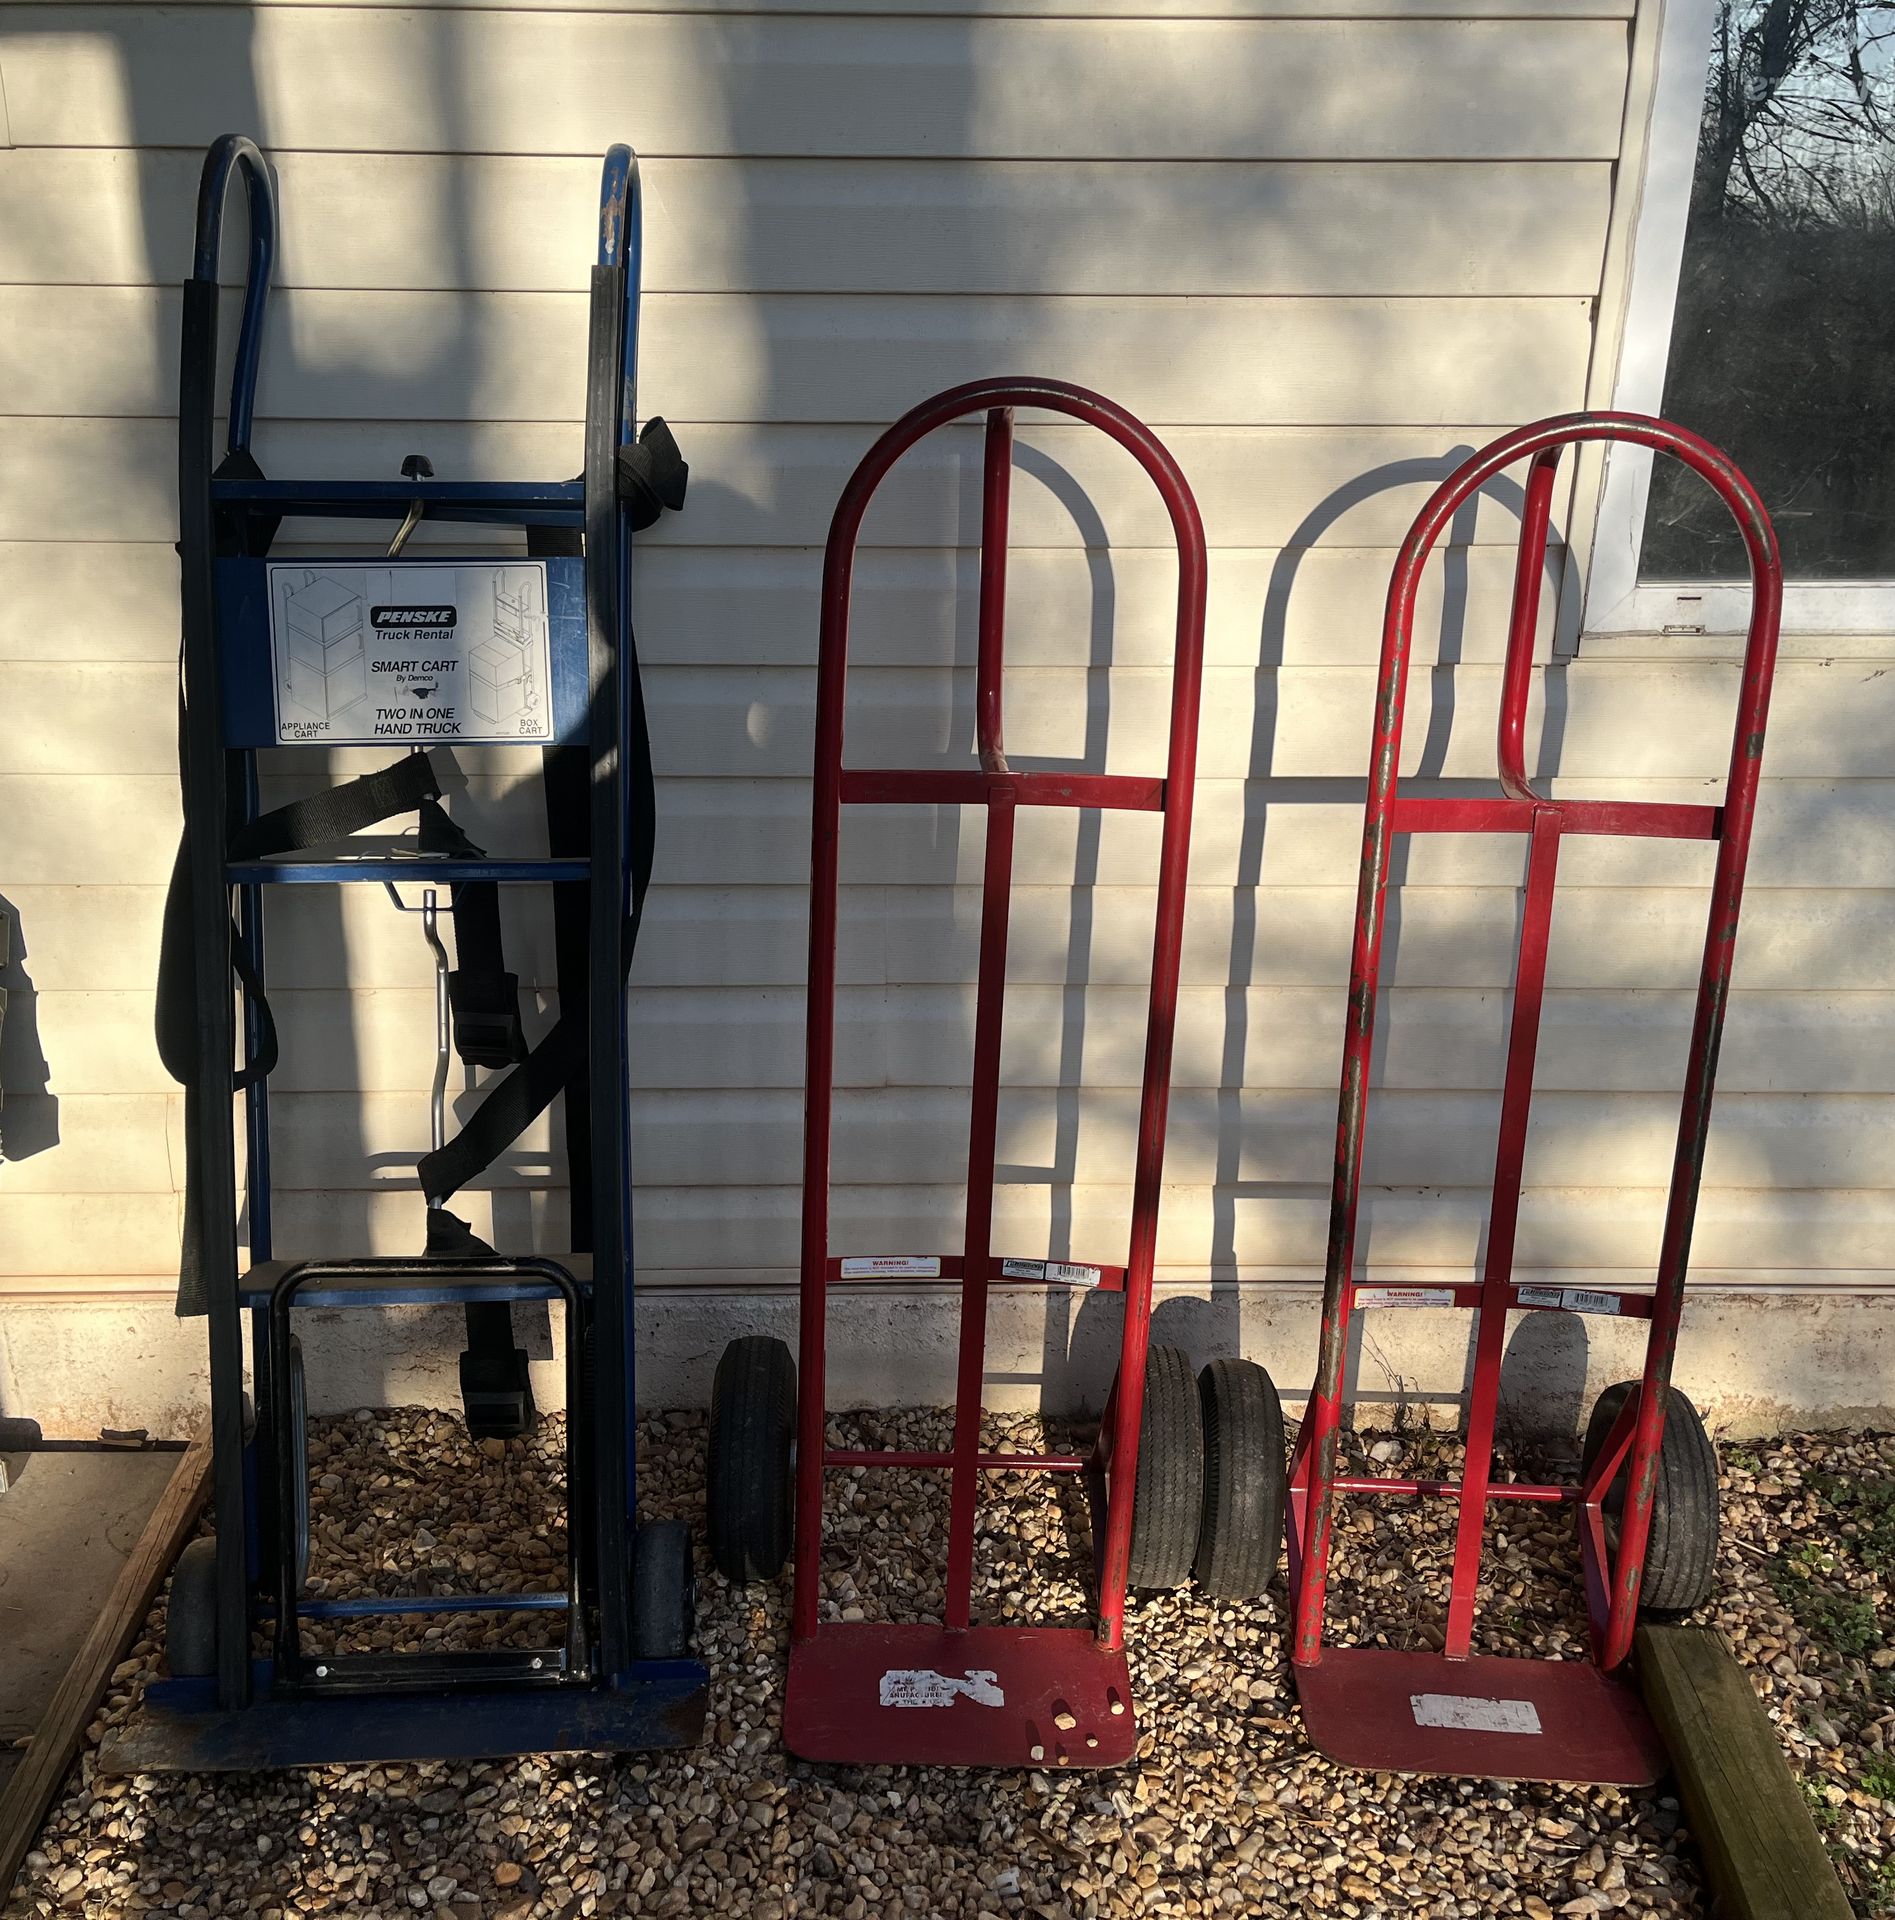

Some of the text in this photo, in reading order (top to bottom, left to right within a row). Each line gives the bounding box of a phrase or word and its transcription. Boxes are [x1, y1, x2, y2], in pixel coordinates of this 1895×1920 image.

[376, 611, 452, 623] PENSKE
[375, 629, 454, 640] Truck Rental
[371, 660, 459, 672] SMART CART
[396, 674, 406, 683] By
[376, 708, 455, 719] TWO IN ONE
[281, 722, 331, 730] APPLIANCE
[374, 722, 461, 734] HAND TRUCK
[520, 719, 538, 727] BOX
[294, 730, 318, 738] CART
[519, 726, 542, 734] CART
